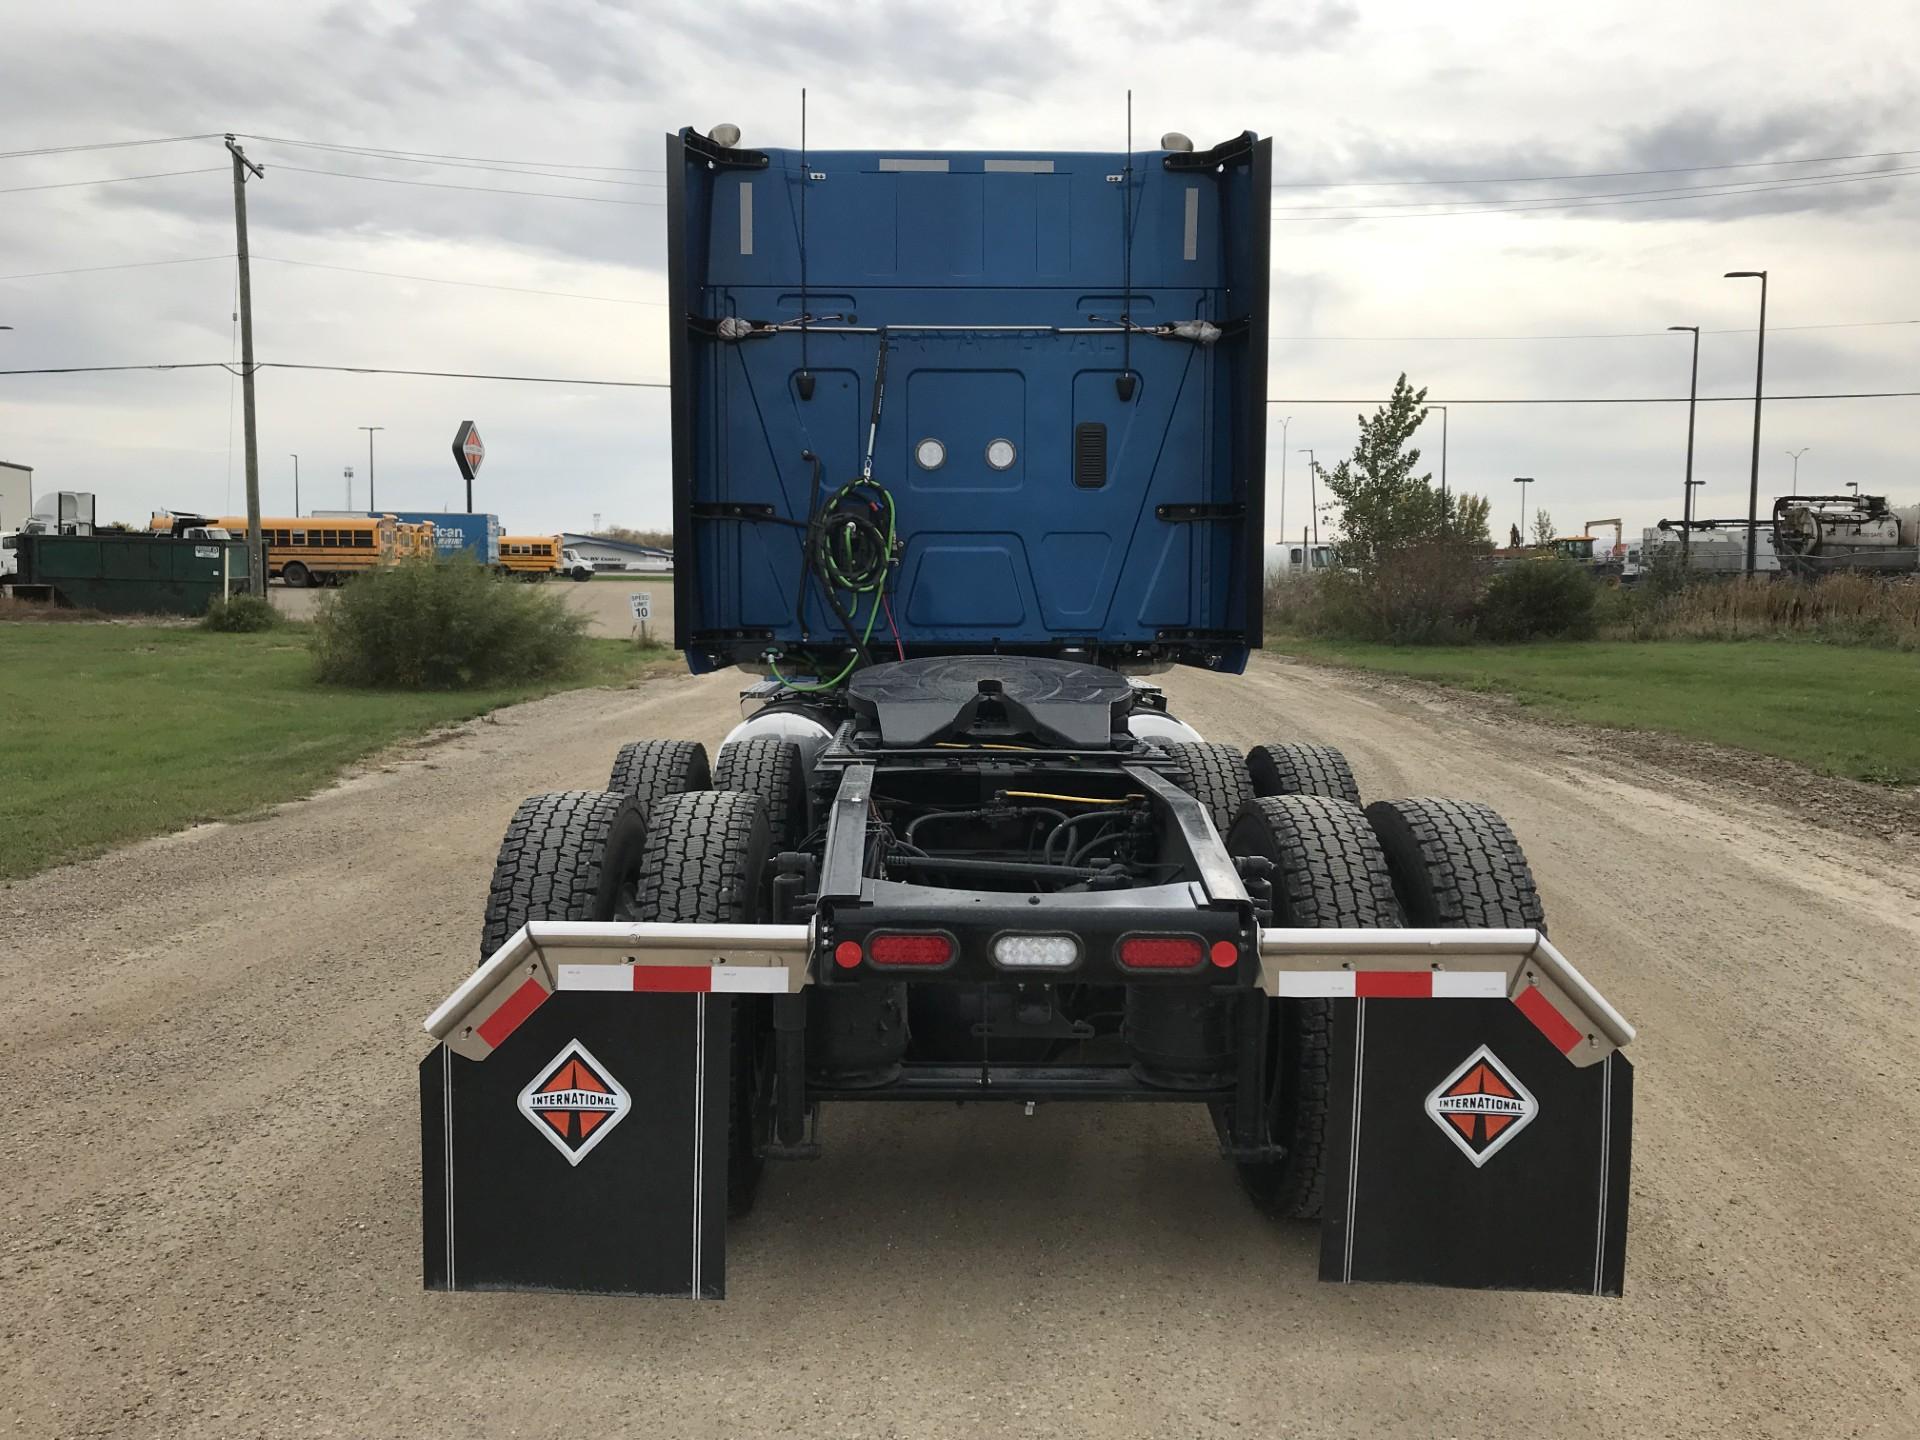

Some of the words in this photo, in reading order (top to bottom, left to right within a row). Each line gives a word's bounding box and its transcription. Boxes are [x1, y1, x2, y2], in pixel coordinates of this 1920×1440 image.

[635, 607, 648, 617] 10
[532, 1093, 616, 1106] INTERNATIONAL
[1439, 1097, 1524, 1111] INTERNATIONAL
